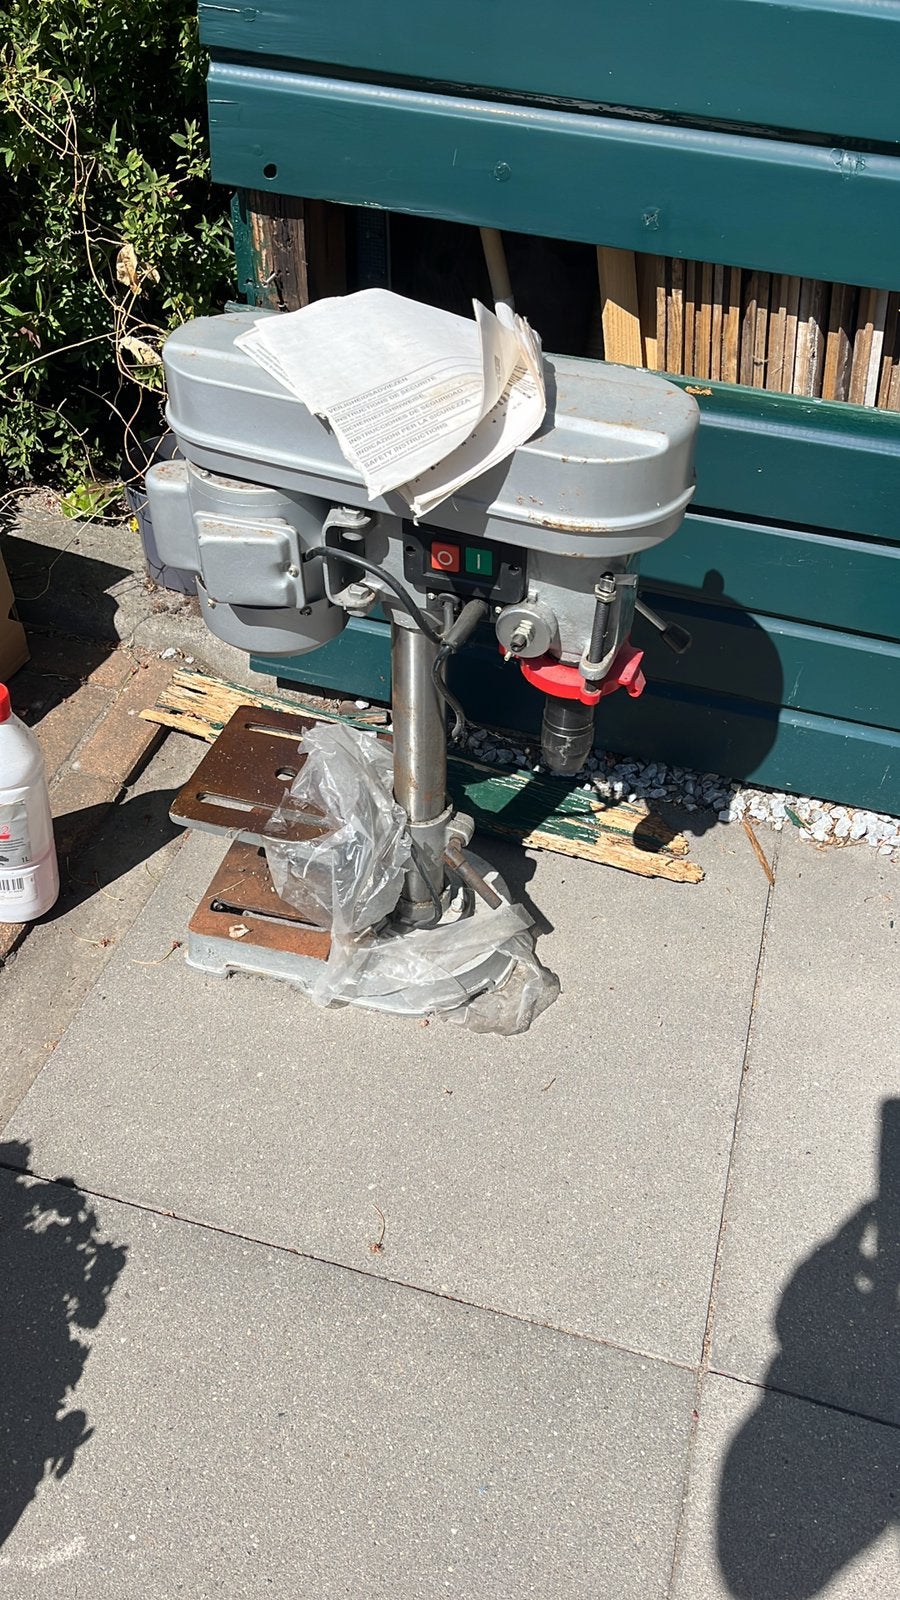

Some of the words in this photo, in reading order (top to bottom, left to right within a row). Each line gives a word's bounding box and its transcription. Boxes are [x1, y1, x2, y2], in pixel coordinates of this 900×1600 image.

[335, 397, 388, 423] INSTRUCTIONS
[389, 392, 399, 400] DE
[349, 414, 408, 444] INSTRUCCIONES
[409, 408, 420, 416] DE
[420, 388, 463, 411] SEGURIDAD
[356, 430, 400, 457] INDICAZIONI
[401, 422, 417, 434] PER
[417, 418, 428, 426] LA
[429, 398, 470, 420] SICUREZZA
[364, 449, 393, 469] SAFETY
[393, 422, 448, 454] INSTRUCTIONS
